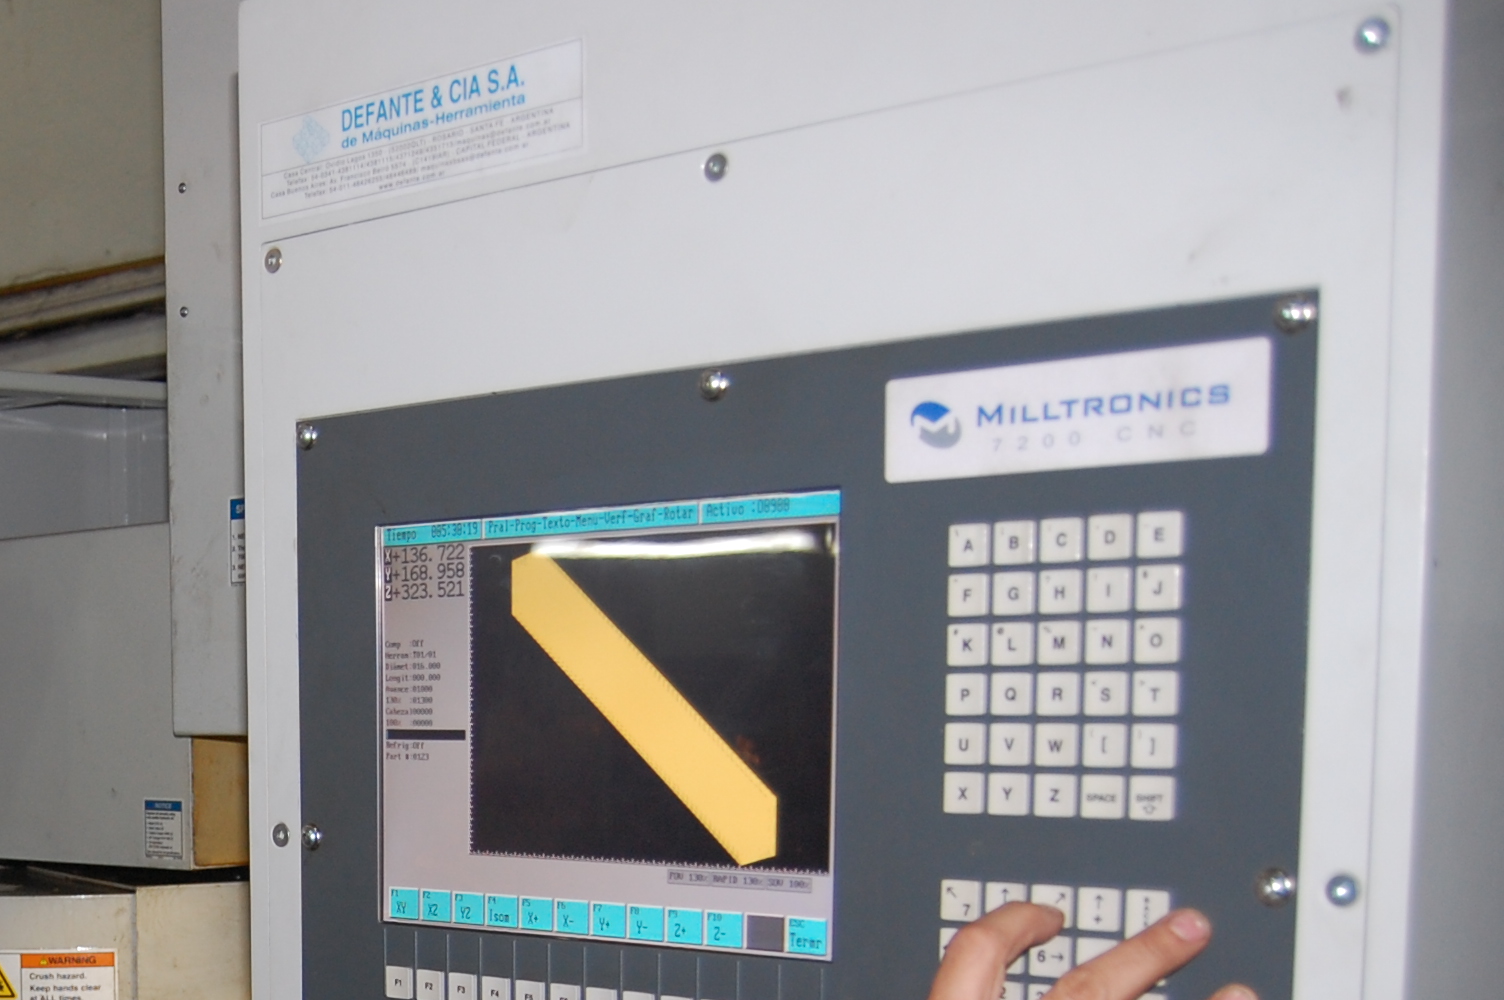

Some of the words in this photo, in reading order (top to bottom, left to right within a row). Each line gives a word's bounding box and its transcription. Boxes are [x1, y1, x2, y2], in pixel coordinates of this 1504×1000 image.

[342, 89, 424, 132] DEFANTE
[430, 84, 443, 108] &
[450, 75, 480, 104] CIA
[488, 65, 524, 94] S.A.
[993, 432, 1081, 451] 7200
[1116, 421, 1196, 443] CNC
[387, 529, 416, 542] Tiempo
[706, 503, 744, 517] Activo
[964, 540, 973, 551] A
[1010, 537, 1019, 549] B
[1057, 534, 1066, 546] C
[1105, 530, 1115, 544] D
[1155, 528, 1163, 541] E
[964, 589, 971, 601] F
[1008, 588, 1019, 600] G
[1055, 587, 1064, 599] H
[1153, 582, 1162, 595] J
[962, 639, 972, 651] K
[1008, 638, 1015, 650] L
[1054, 637, 1064, 649] M
[1102, 636, 1112, 647] N
[1151, 634, 1162, 647] O
[961, 689, 969, 700] P
[1005, 688, 1016, 700] Q
[1053, 688, 1062, 700] R
[1101, 689, 1110, 701] S
[1151, 688, 1159, 701] T
[960, 739, 968, 750] U
[1005, 738, 1014, 750] V
[1049, 740, 1062, 752] W
[959, 788, 967, 800] X
[1003, 788, 1012, 800] Y
[1050, 789, 1059, 801] Z
[396, 902, 406, 914] XY
[963, 904, 970, 916] 7
[49, 956, 96, 964] WARNING
[1037, 950, 1045, 962] 6
[30, 985, 50, 993] Keep
[425, 982, 433, 990] F2
[457, 986, 465, 994] F3
[491, 989, 499, 997] F4
